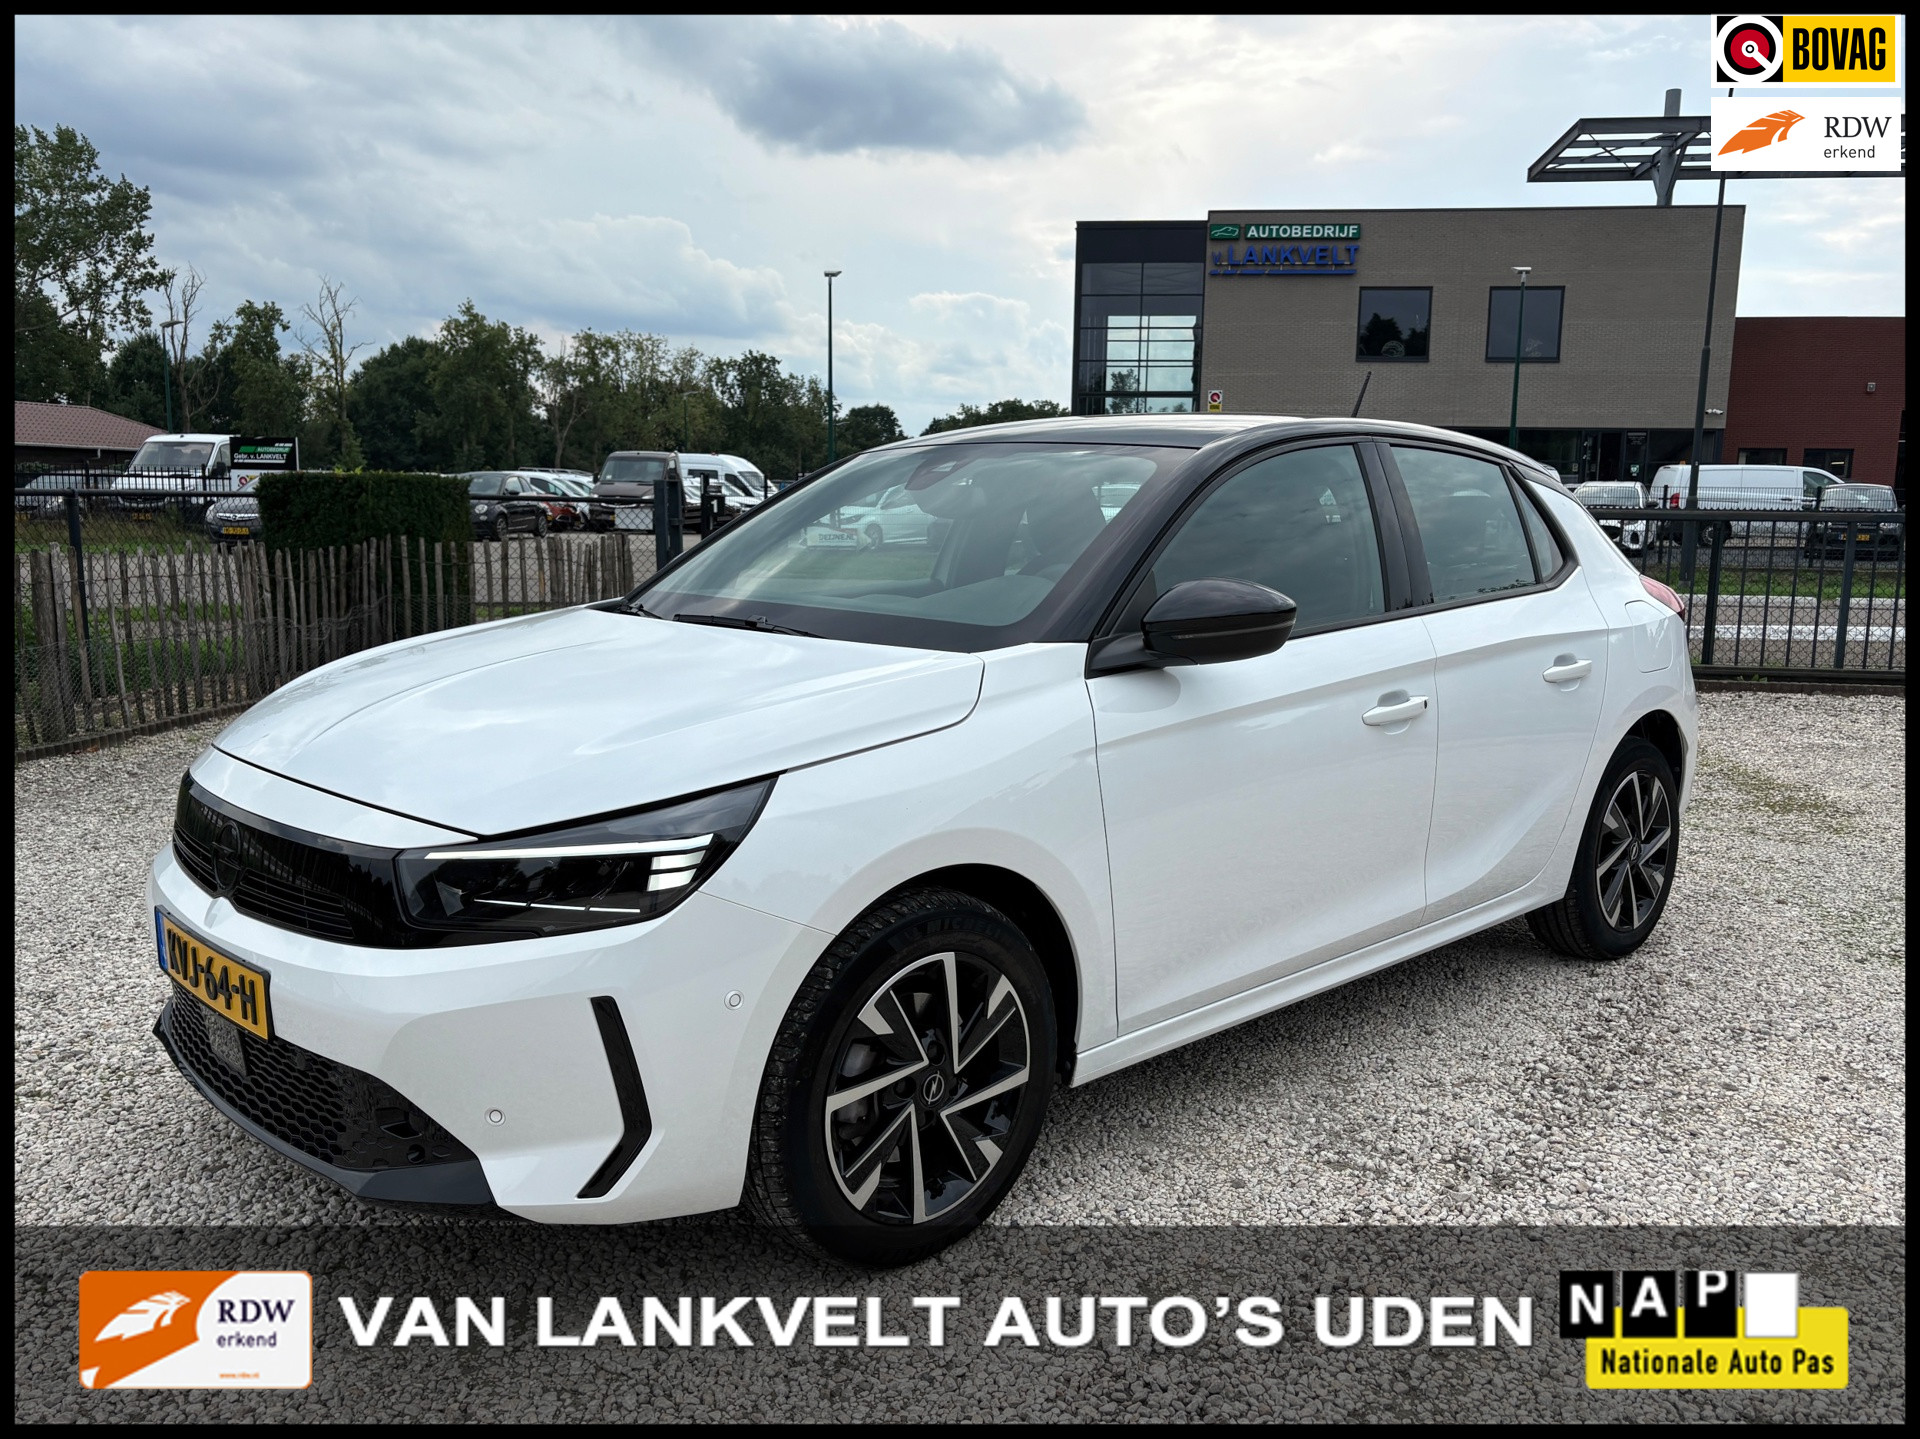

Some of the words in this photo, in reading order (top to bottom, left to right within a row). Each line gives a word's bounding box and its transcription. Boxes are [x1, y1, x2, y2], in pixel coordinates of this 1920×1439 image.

[1246, 225, 1358, 238] AUTOBEDRIJF
[1227, 245, 1360, 265] LANKVELT
[710, 499, 718, 513] 1
[166, 928, 258, 1026] KVJ-64-H
